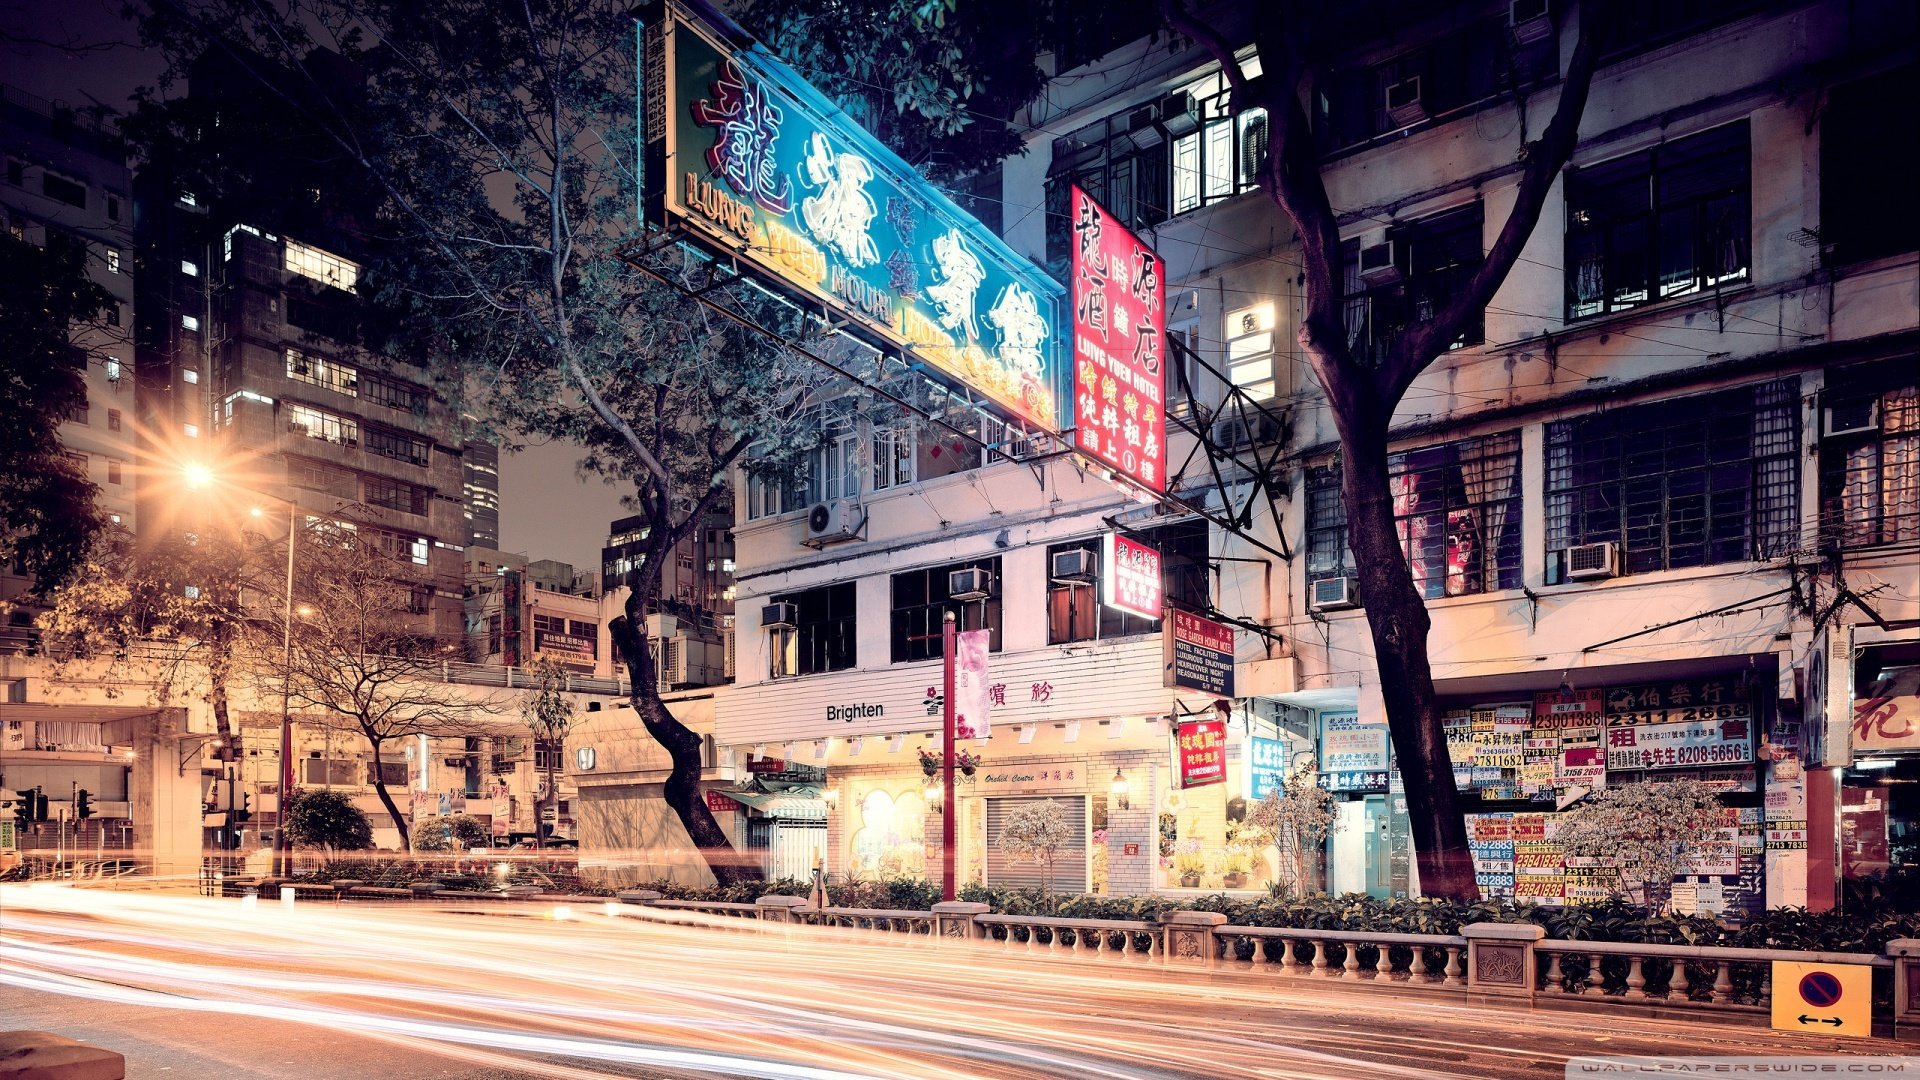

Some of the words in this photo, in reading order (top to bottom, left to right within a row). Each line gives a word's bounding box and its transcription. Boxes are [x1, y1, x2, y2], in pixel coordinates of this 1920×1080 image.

[685, 172, 757, 241] LUNG
[1107, 354, 1132, 385] YUEN
[1133, 371, 1160, 404] HOTEL
[1176, 626, 1188, 640] ROSE
[1188, 630, 1204, 645] GARDEN
[1204, 635, 1219, 649] HOURLY
[1176, 641, 1193, 653] HOTEL
[1193, 647, 1219, 660] FACILITIES
[1176, 650, 1204, 665] LUXURIOUS
[1205, 658, 1233, 672] ENJOYMENT
[1176, 668, 1210, 683] REASONABLE
[1210, 676, 1225, 687] PRICE
[1209, 668, 1225, 678] NIGHT
[826, 702, 884, 723] Brighten
[1536, 711, 1601, 729] 23001388
[1608, 710, 1669, 727] 2311
[1682, 704, 1750, 721] 2668
[1609, 728, 1637, 748] 租
[1719, 719, 1749, 741] 售
[1181, 732, 1215, 751] 玫瑰園
[1482, 734, 1522, 746] 永昇物業
[1474, 755, 1522, 767] 27811682
[984, 774, 1009, 783] Orchid
[1011, 774, 1035, 783] Centre
[1563, 768, 1584, 777] 3156
[1584, 767, 1604, 776] 2680
[1710, 772, 1732, 781] 3156
[1488, 840, 1513, 850] 2883
[1481, 862, 1510, 871] 租/售
[1566, 868, 1590, 876] 2311
[1592, 868, 1617, 876] 2668
[1489, 875, 1513, 886] 2883
[1516, 883, 1563, 897] 23841838
